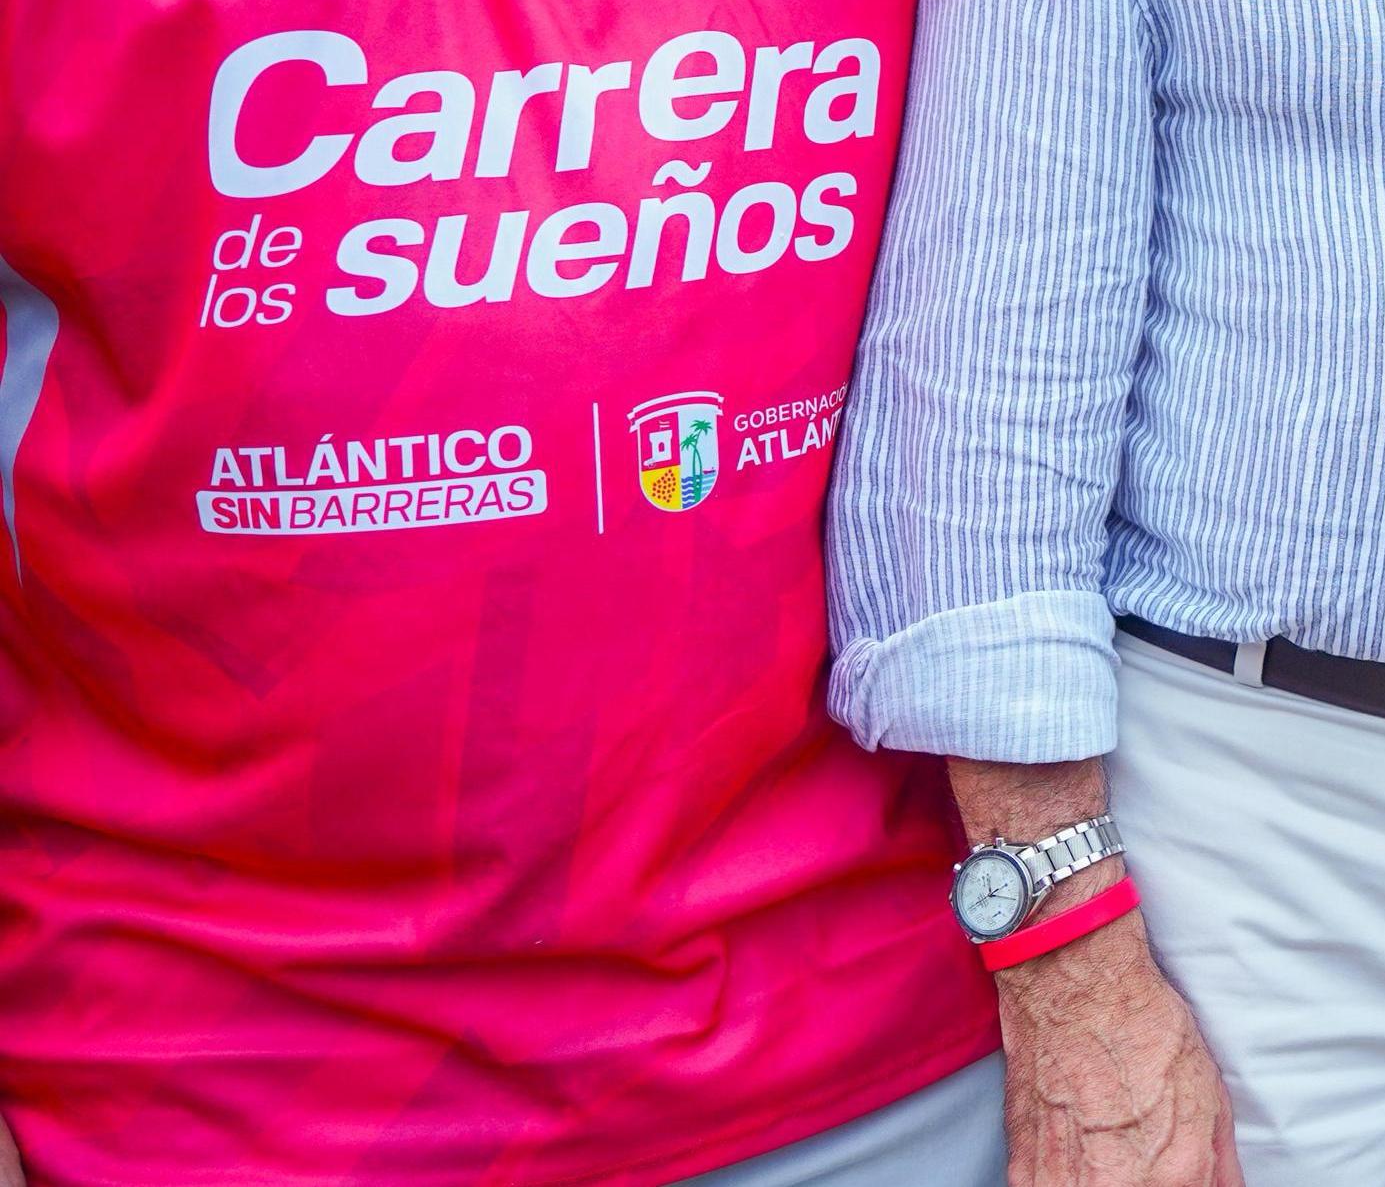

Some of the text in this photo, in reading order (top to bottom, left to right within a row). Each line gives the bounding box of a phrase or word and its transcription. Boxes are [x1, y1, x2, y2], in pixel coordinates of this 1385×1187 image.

[207, 28, 882, 200] Carrera
[199, 160, 859, 329] los sueños
[212, 214, 303, 272] de
[733, 381, 849, 433] GOBERNACIÓ
[736, 406, 844, 471] ATLÁNT
[210, 425, 533, 487] ATLÁNTICO
